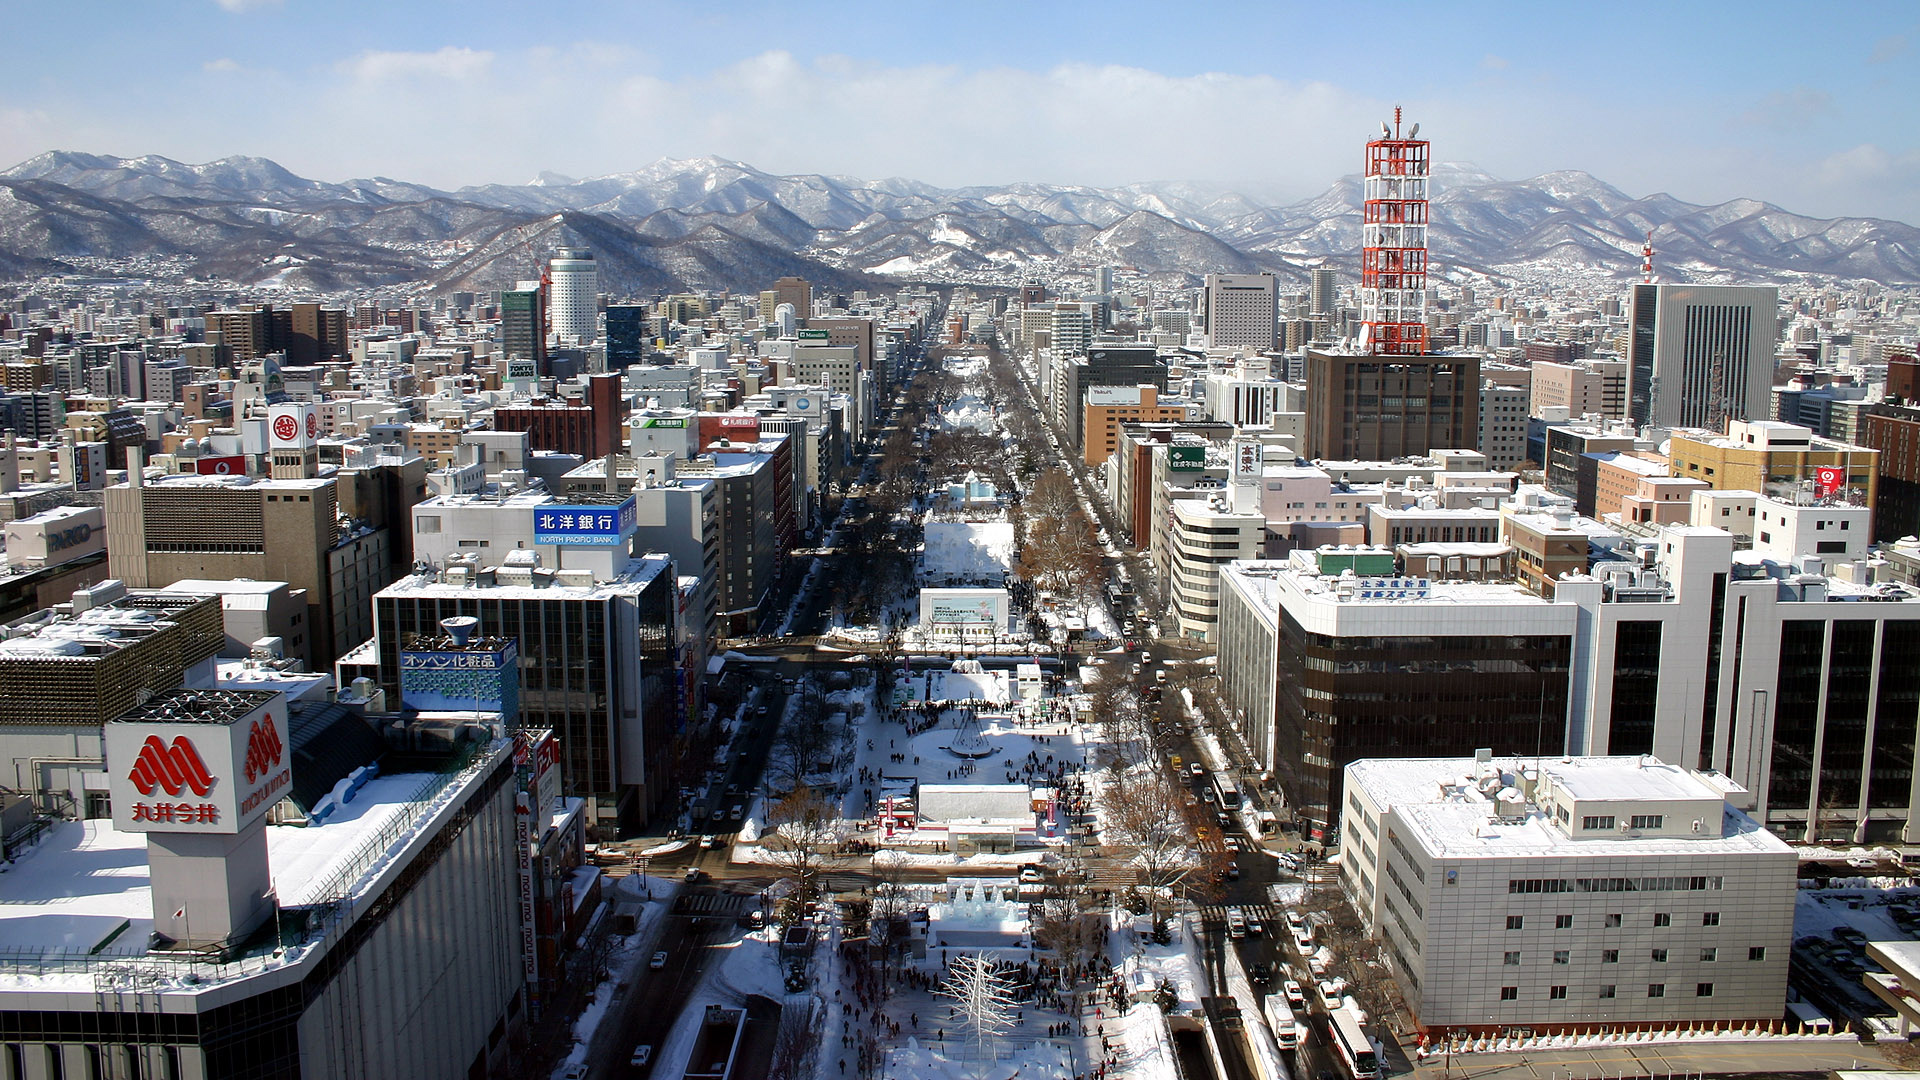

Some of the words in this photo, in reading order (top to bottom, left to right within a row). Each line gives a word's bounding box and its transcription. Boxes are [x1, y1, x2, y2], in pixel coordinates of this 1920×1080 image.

[339, 405, 346, 414] P
[540, 514, 613, 530] 北洋銀行
[48, 523, 91, 553] PARCO
[1360, 579, 1427, 588] 北海道新聞
[403, 654, 496, 668] オッペン化粧品
[132, 802, 219, 823] 丸井今井
